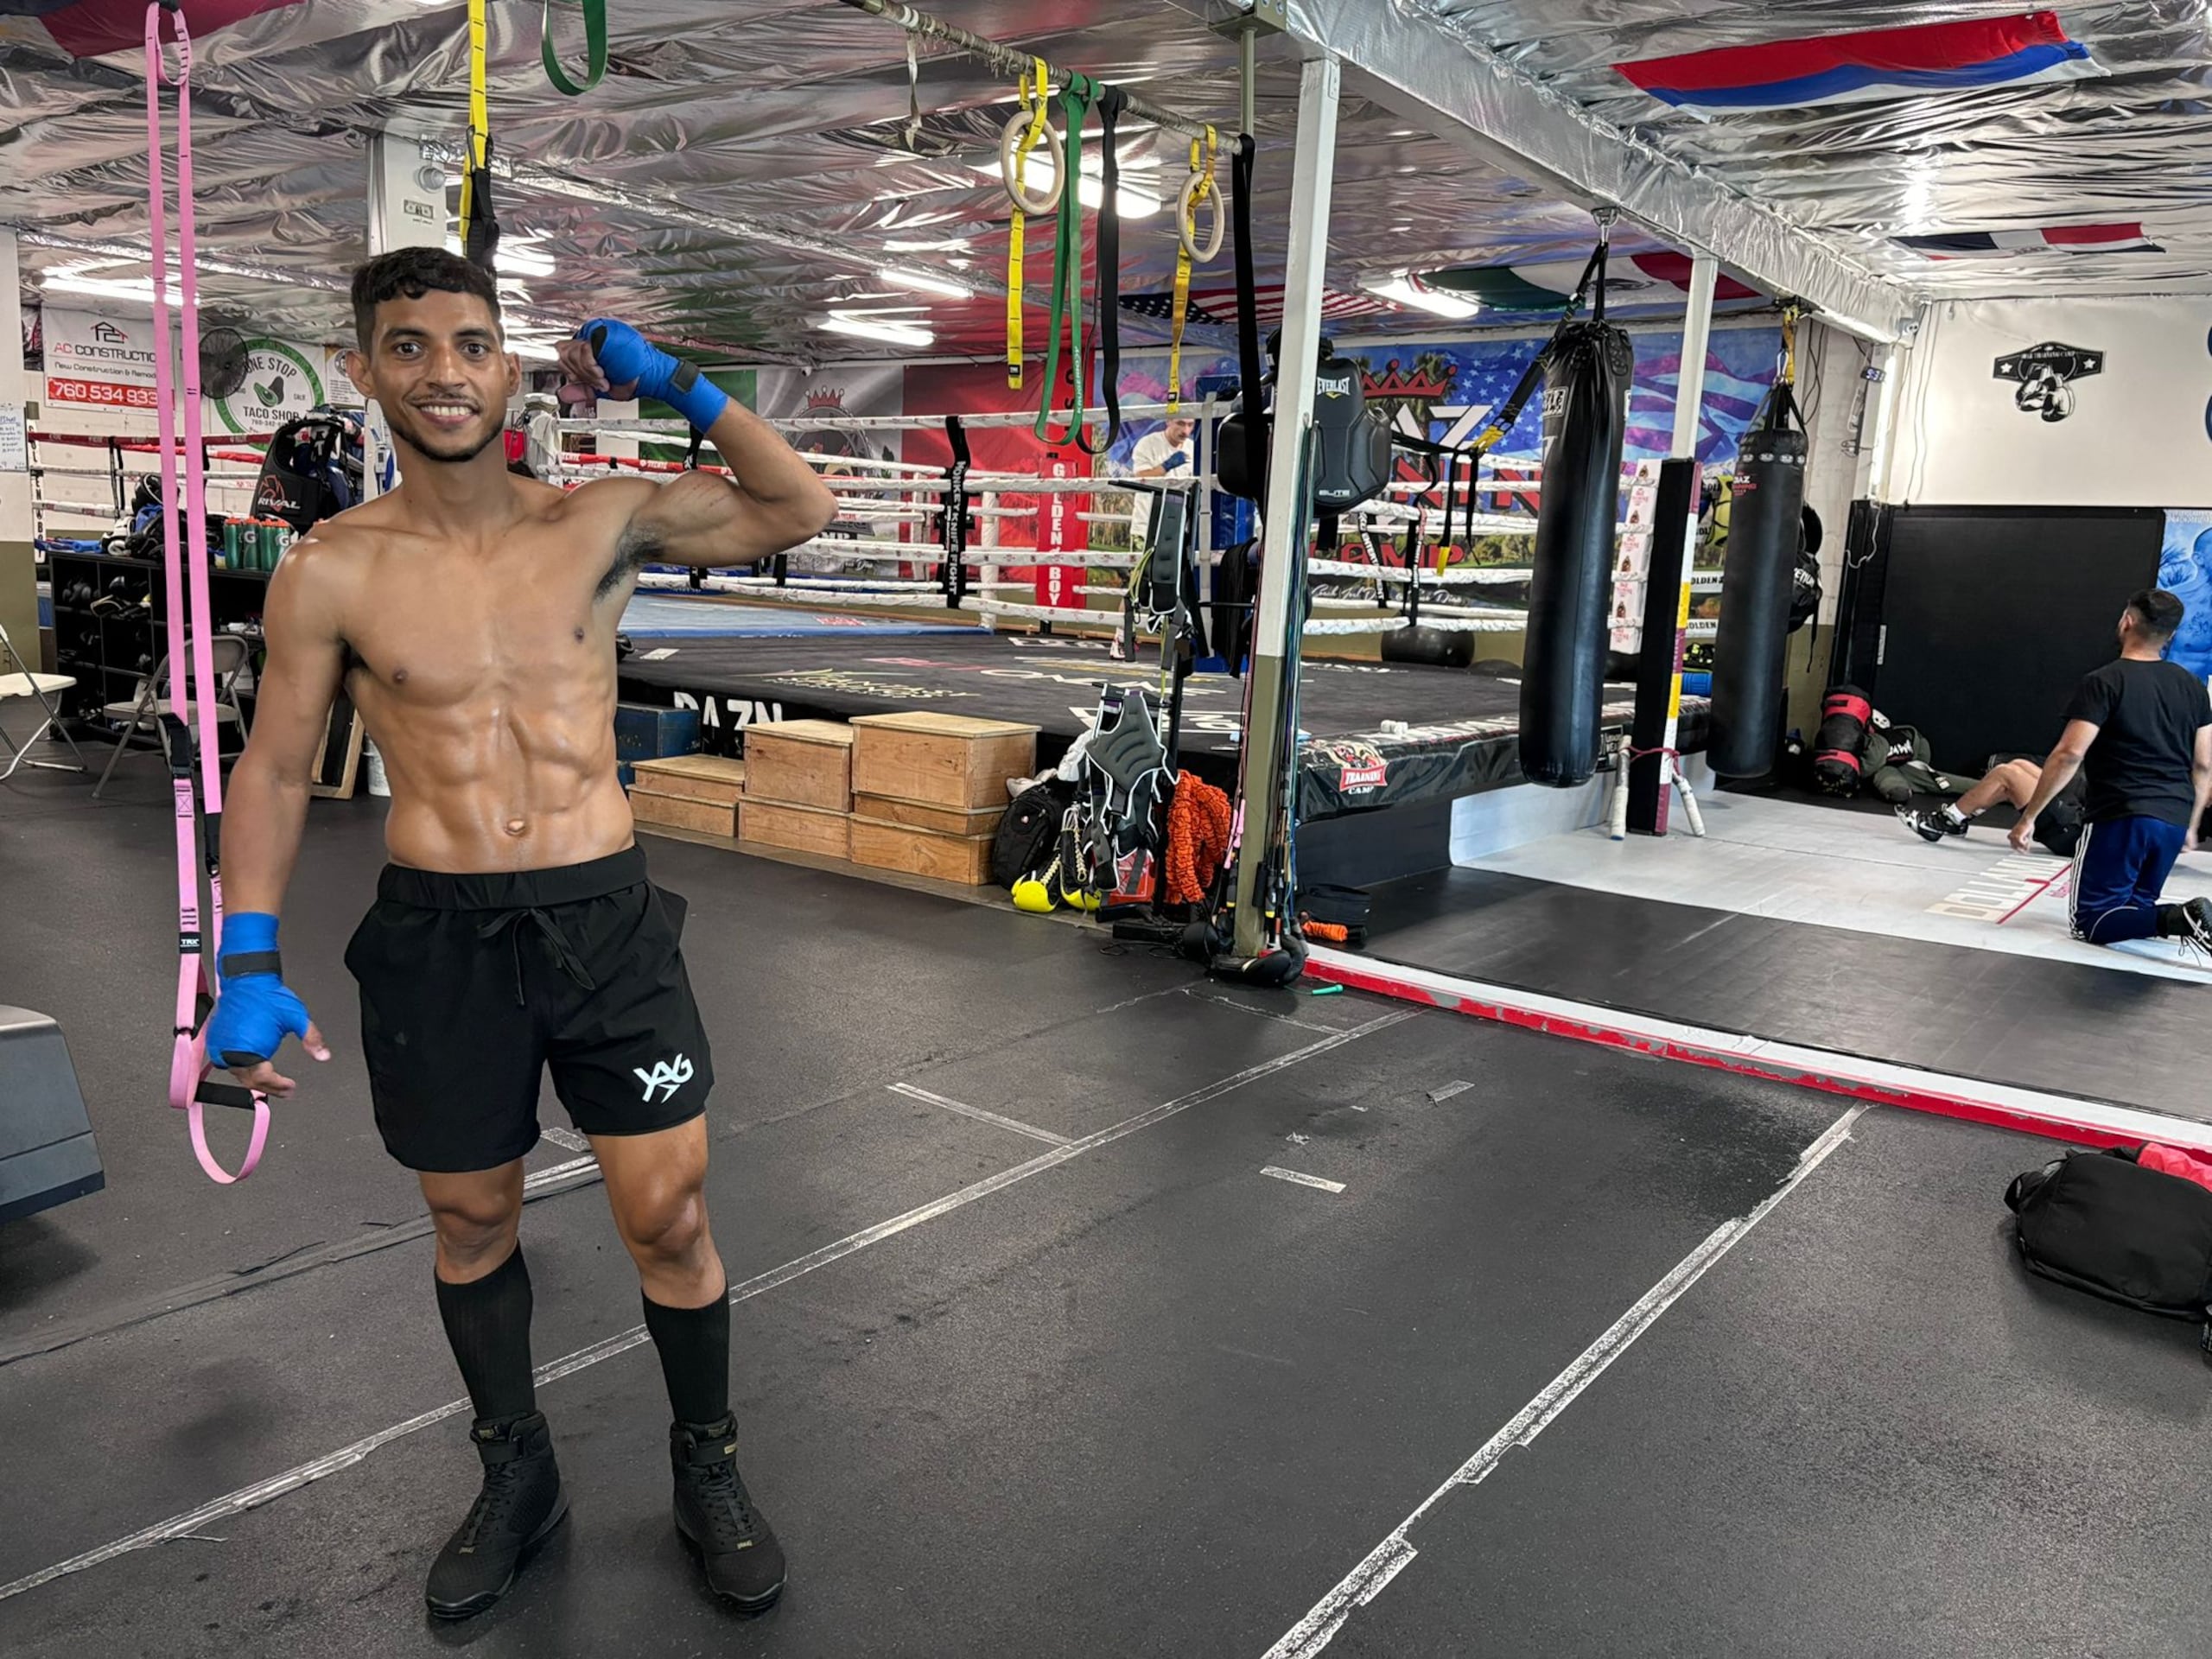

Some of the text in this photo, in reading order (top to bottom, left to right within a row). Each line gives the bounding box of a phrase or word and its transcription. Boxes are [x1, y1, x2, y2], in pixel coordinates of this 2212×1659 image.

[54, 342, 72, 354] AC
[73, 364, 124, 375] Construction
[268, 357, 297, 378] STOP
[1317, 377, 1350, 395] EVERLAST
[243, 406, 269, 418] TACO
[1319, 489, 1350, 498] ELITE
[257, 497, 301, 509] RIVAL
[1051, 463, 1066, 544] GLDEN
[949, 461, 968, 595] MONKEY KNIFE FIGHT
[245, 531, 257, 543] G
[279, 535, 289, 546] G
[1048, 566, 1062, 606] BOY
[674, 691, 783, 730] DAZN
